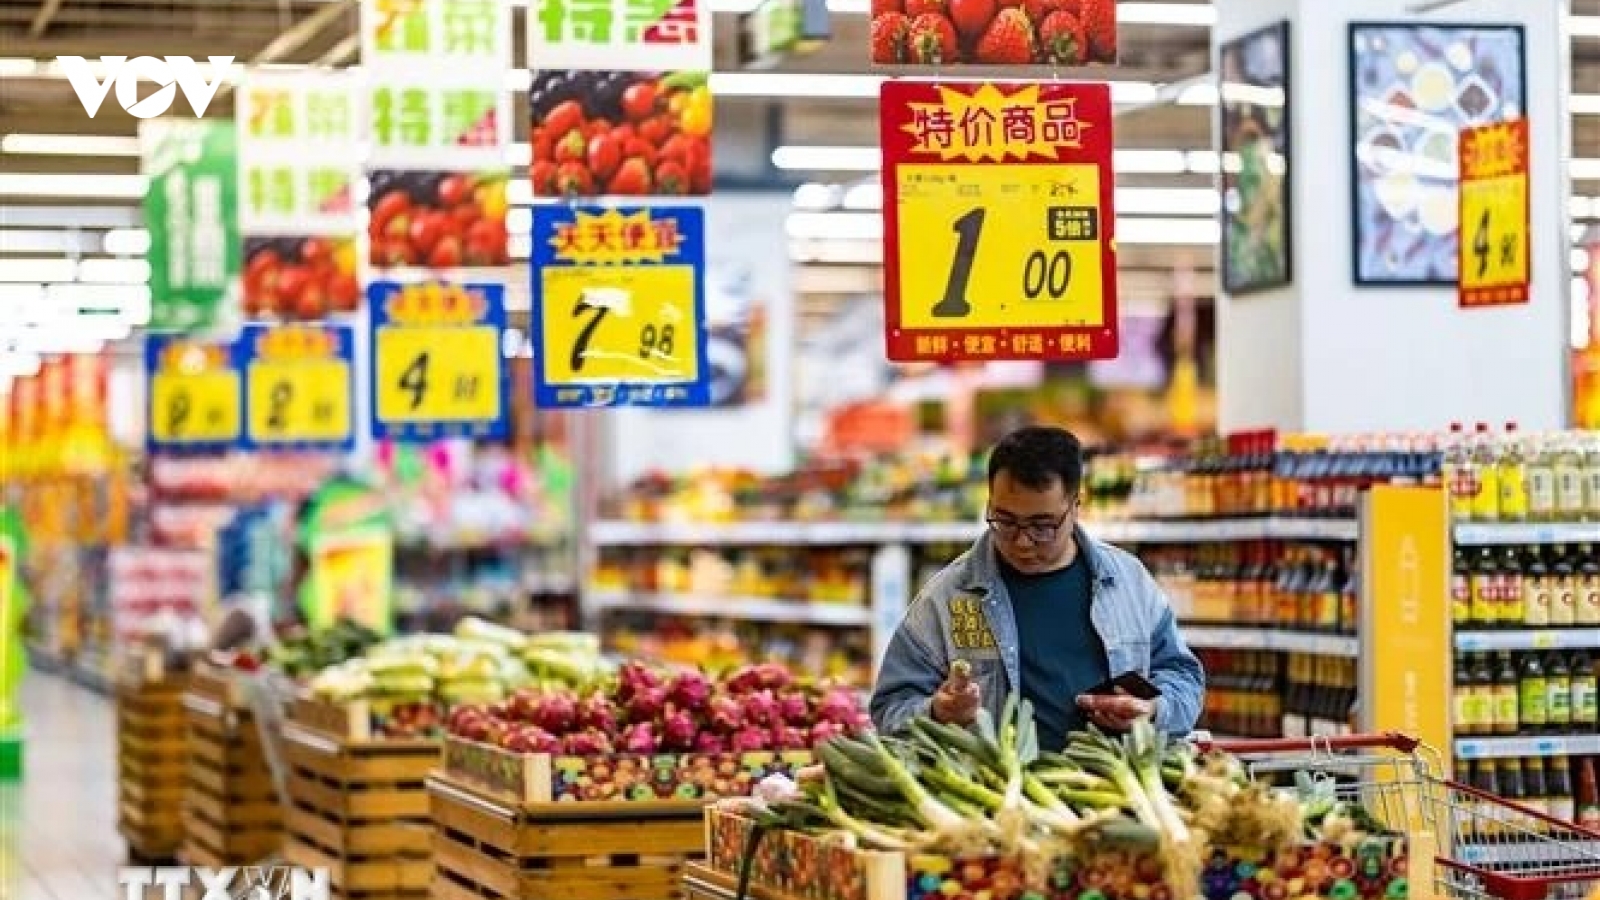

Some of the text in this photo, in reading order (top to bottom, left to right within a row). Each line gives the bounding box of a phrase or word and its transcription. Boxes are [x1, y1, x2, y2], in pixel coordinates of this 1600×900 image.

[915, 105, 1081, 149] 特价商品
[931, 206, 1072, 317] 1 00
[1474, 209, 1490, 278] 4
[570, 292, 675, 373] 7 98
[398, 352, 429, 411] 4
